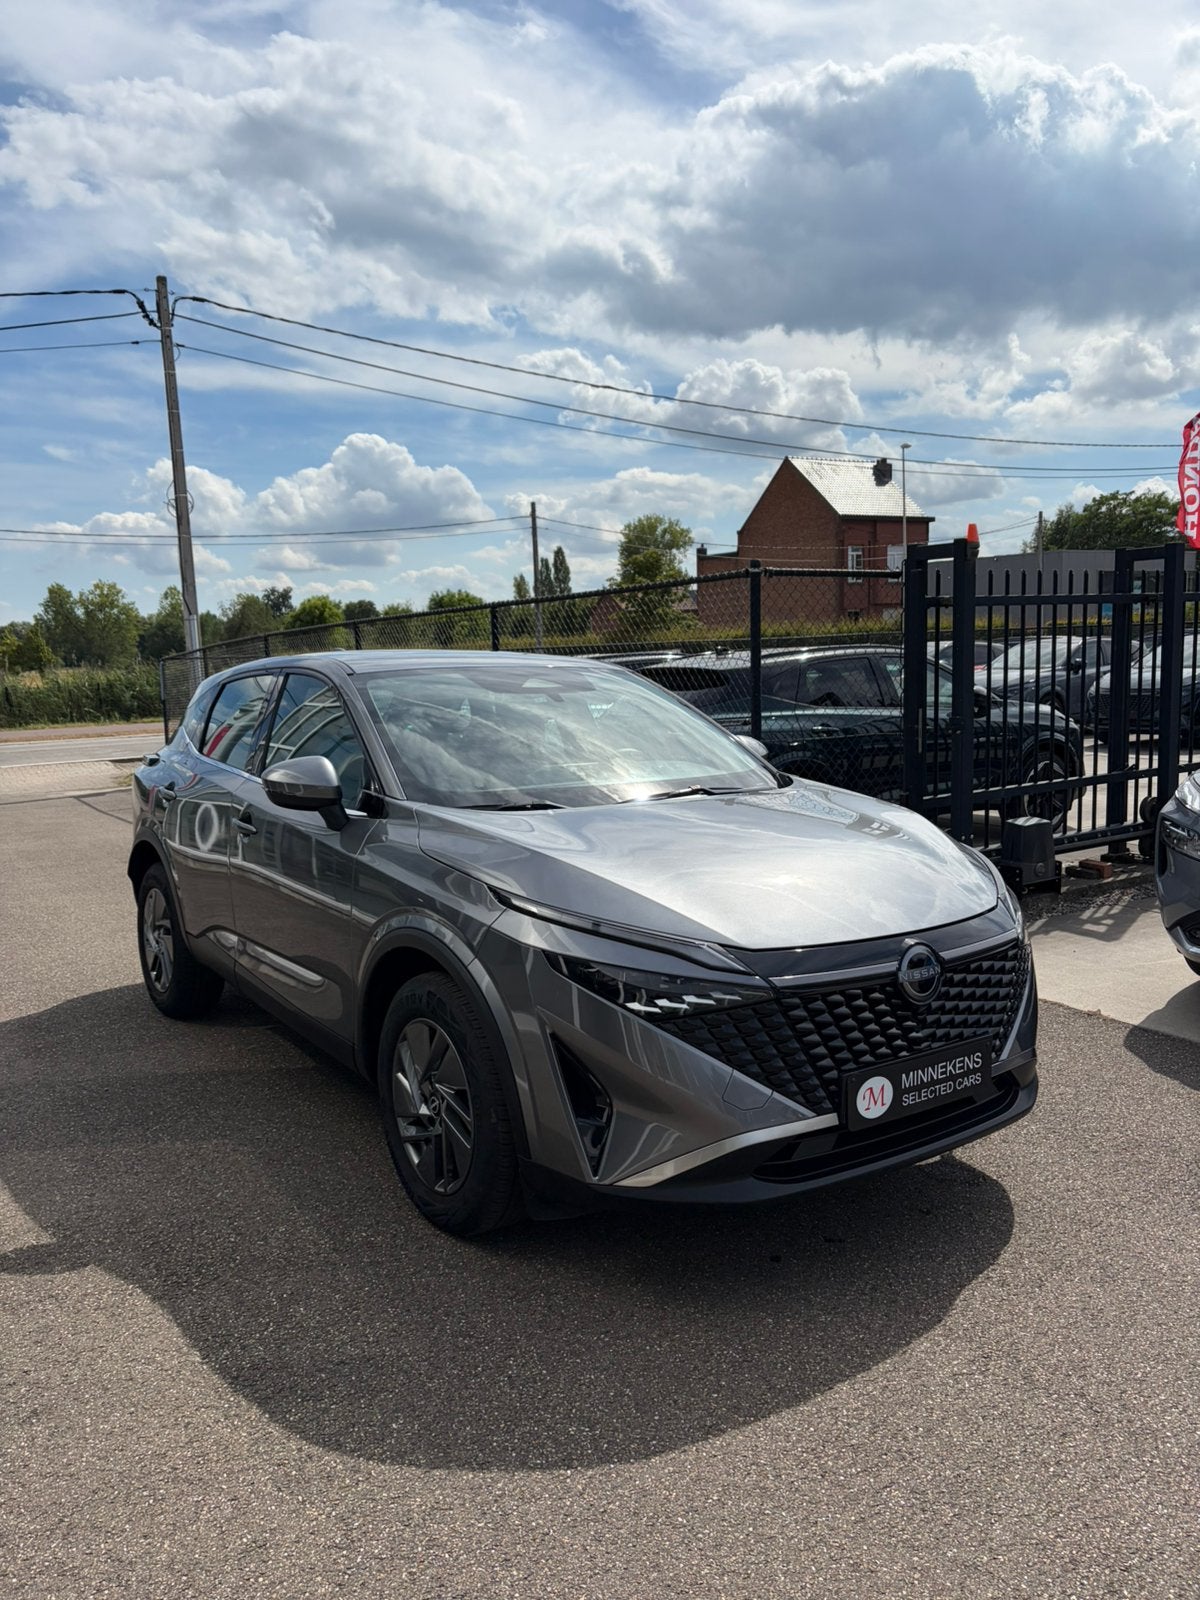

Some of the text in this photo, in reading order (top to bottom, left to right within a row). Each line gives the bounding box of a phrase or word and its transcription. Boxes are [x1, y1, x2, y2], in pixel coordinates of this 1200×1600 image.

[899, 966, 941, 981] NISSAN
[902, 1052, 982, 1089] MINNEKENS
[862, 1084, 886, 1111] M
[902, 1073, 982, 1106] SELECTED CARS
